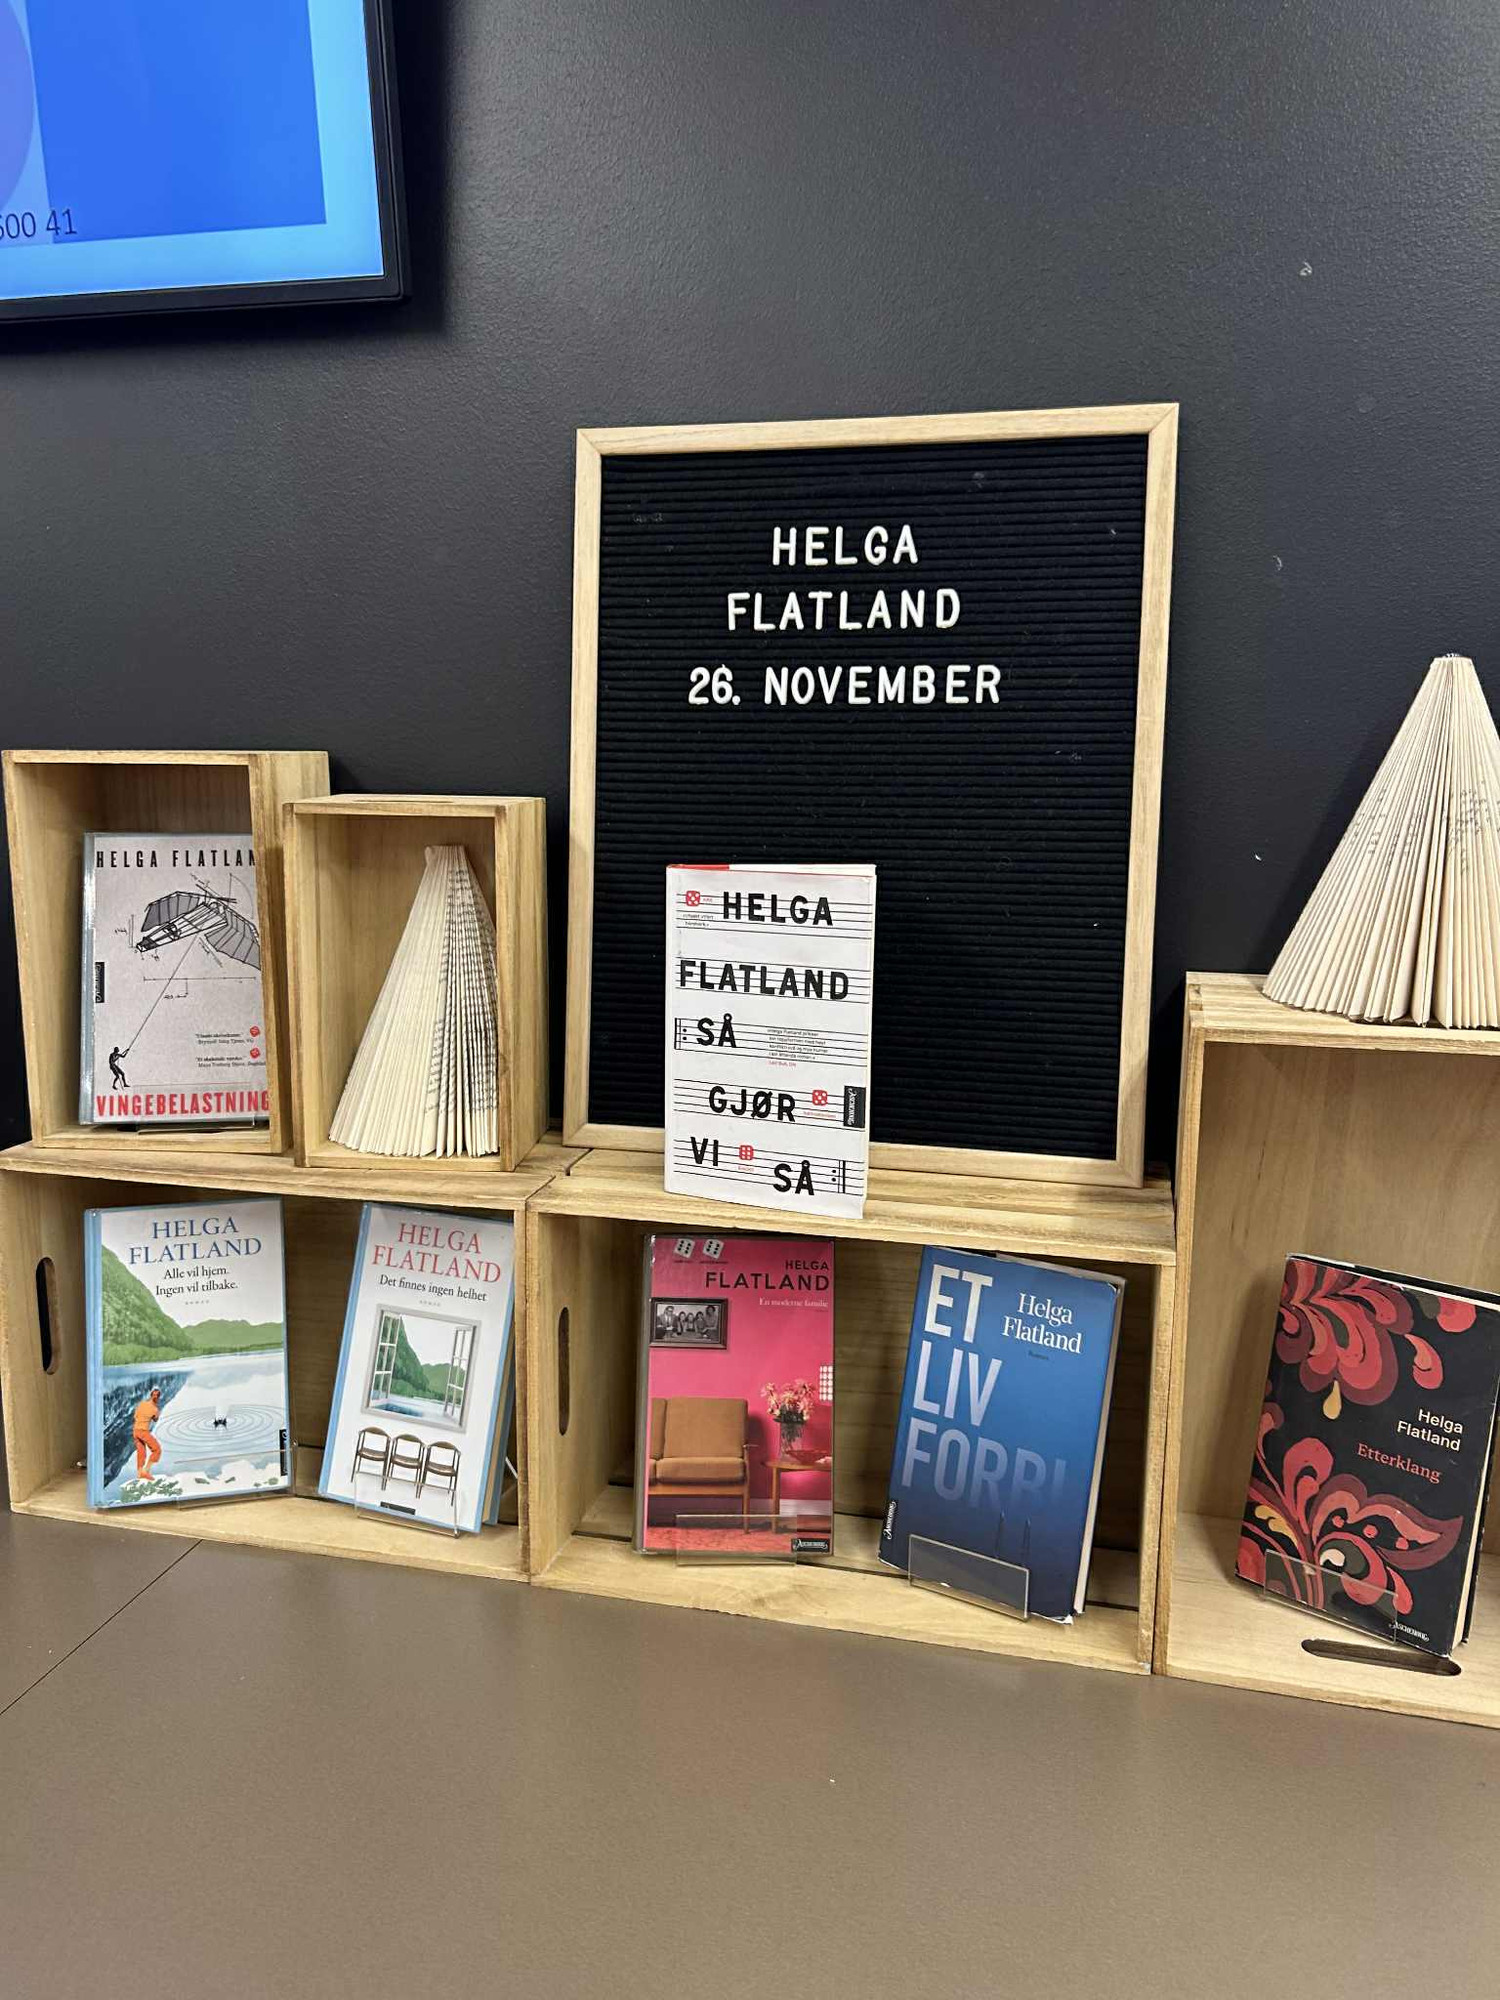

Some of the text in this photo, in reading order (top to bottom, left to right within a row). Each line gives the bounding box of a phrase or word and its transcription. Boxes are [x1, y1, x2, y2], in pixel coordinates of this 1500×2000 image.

[46, 208, 78, 235] 41
[772, 524, 919, 566] HELGA
[727, 588, 961, 631] FLATLAND
[688, 664, 1001, 706] 26. NOVEMBER
[96, 849, 256, 868] HELGA FLATLAN
[723, 891, 834, 926] HELGA
[680, 959, 849, 1000] FLATLAND
[696, 1013, 737, 1049] SÅ
[96, 1090, 269, 1117] VINGEBELASTNING
[709, 1086, 796, 1123] GJØR
[690, 1136, 719, 1167] VI
[773, 1159, 815, 1196] SÅ
[152, 1216, 239, 1239] HELGA
[398, 1223, 481, 1254] HELGA
[129, 1238, 262, 1265] FLATLAND
[372, 1244, 501, 1283] FLATLAND
[785, 1260, 829, 1271] HELGA
[156, 1279, 239, 1298] Ingen vil tilbake.
[164, 1265, 230, 1280] Alle vil hjem.
[379, 1273, 487, 1302] Det finnes ingen helhet
[705, 1271, 830, 1292] FLATLAND
[924, 1263, 993, 1344] ET
[1017, 1292, 1073, 1328] Helga
[1001, 1315, 1082, 1354] Flatland
[913, 1340, 1003, 1428] LIV
[1397, 1420, 1461, 1452] Flatland
[1418, 1408, 1463, 1435] Helga
[1357, 1443, 1442, 1485] Etterklang
